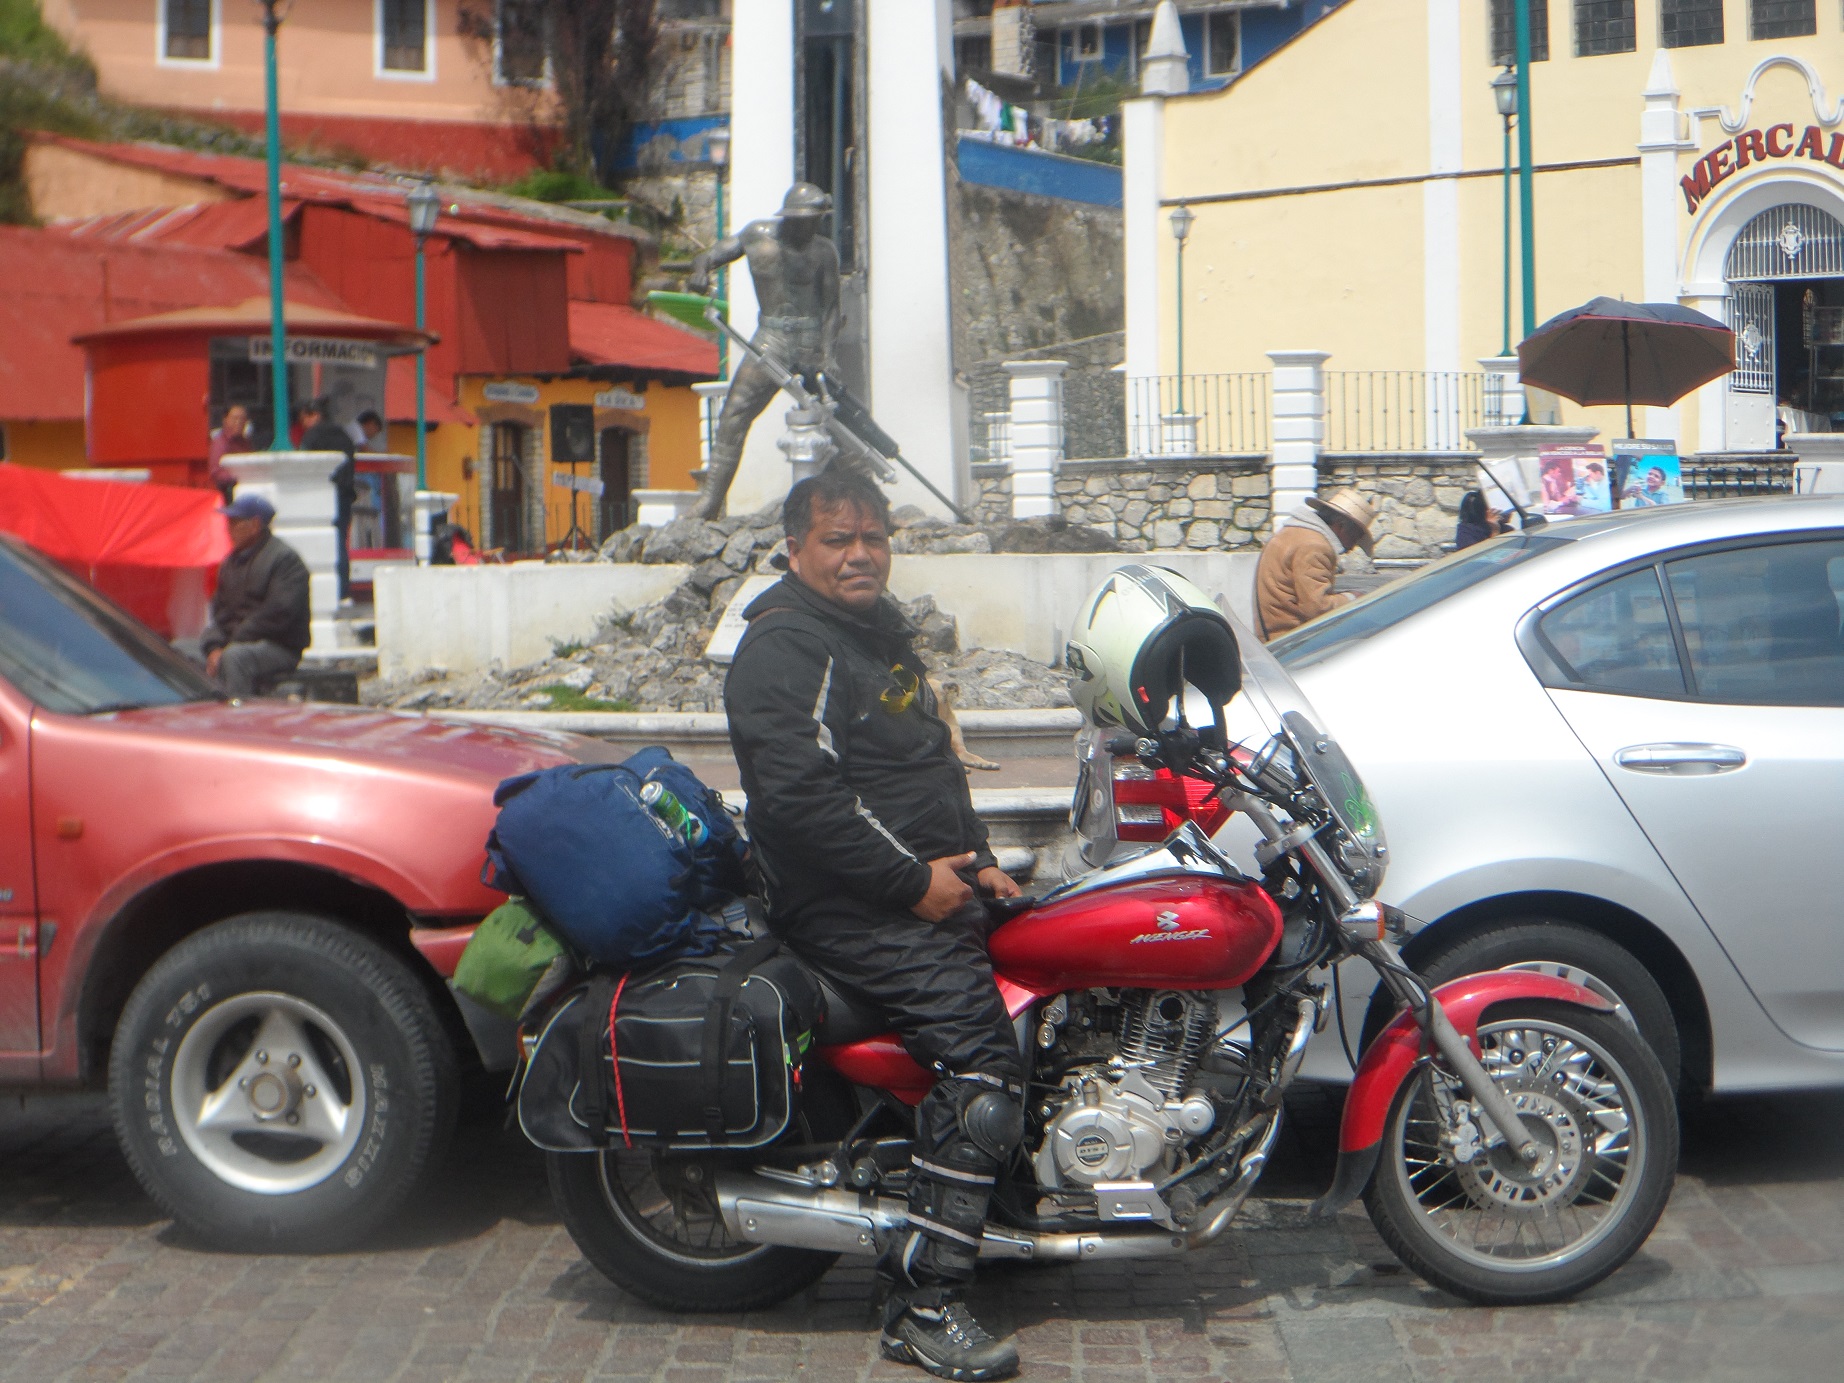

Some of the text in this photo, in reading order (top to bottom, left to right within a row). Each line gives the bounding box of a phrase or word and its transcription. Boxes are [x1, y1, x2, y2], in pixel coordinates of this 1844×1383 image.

[1130, 928, 1213, 945] AVENGER
[145, 1037, 177, 1157] RADIAL
[344, 1063, 388, 1189] MAXXIS
